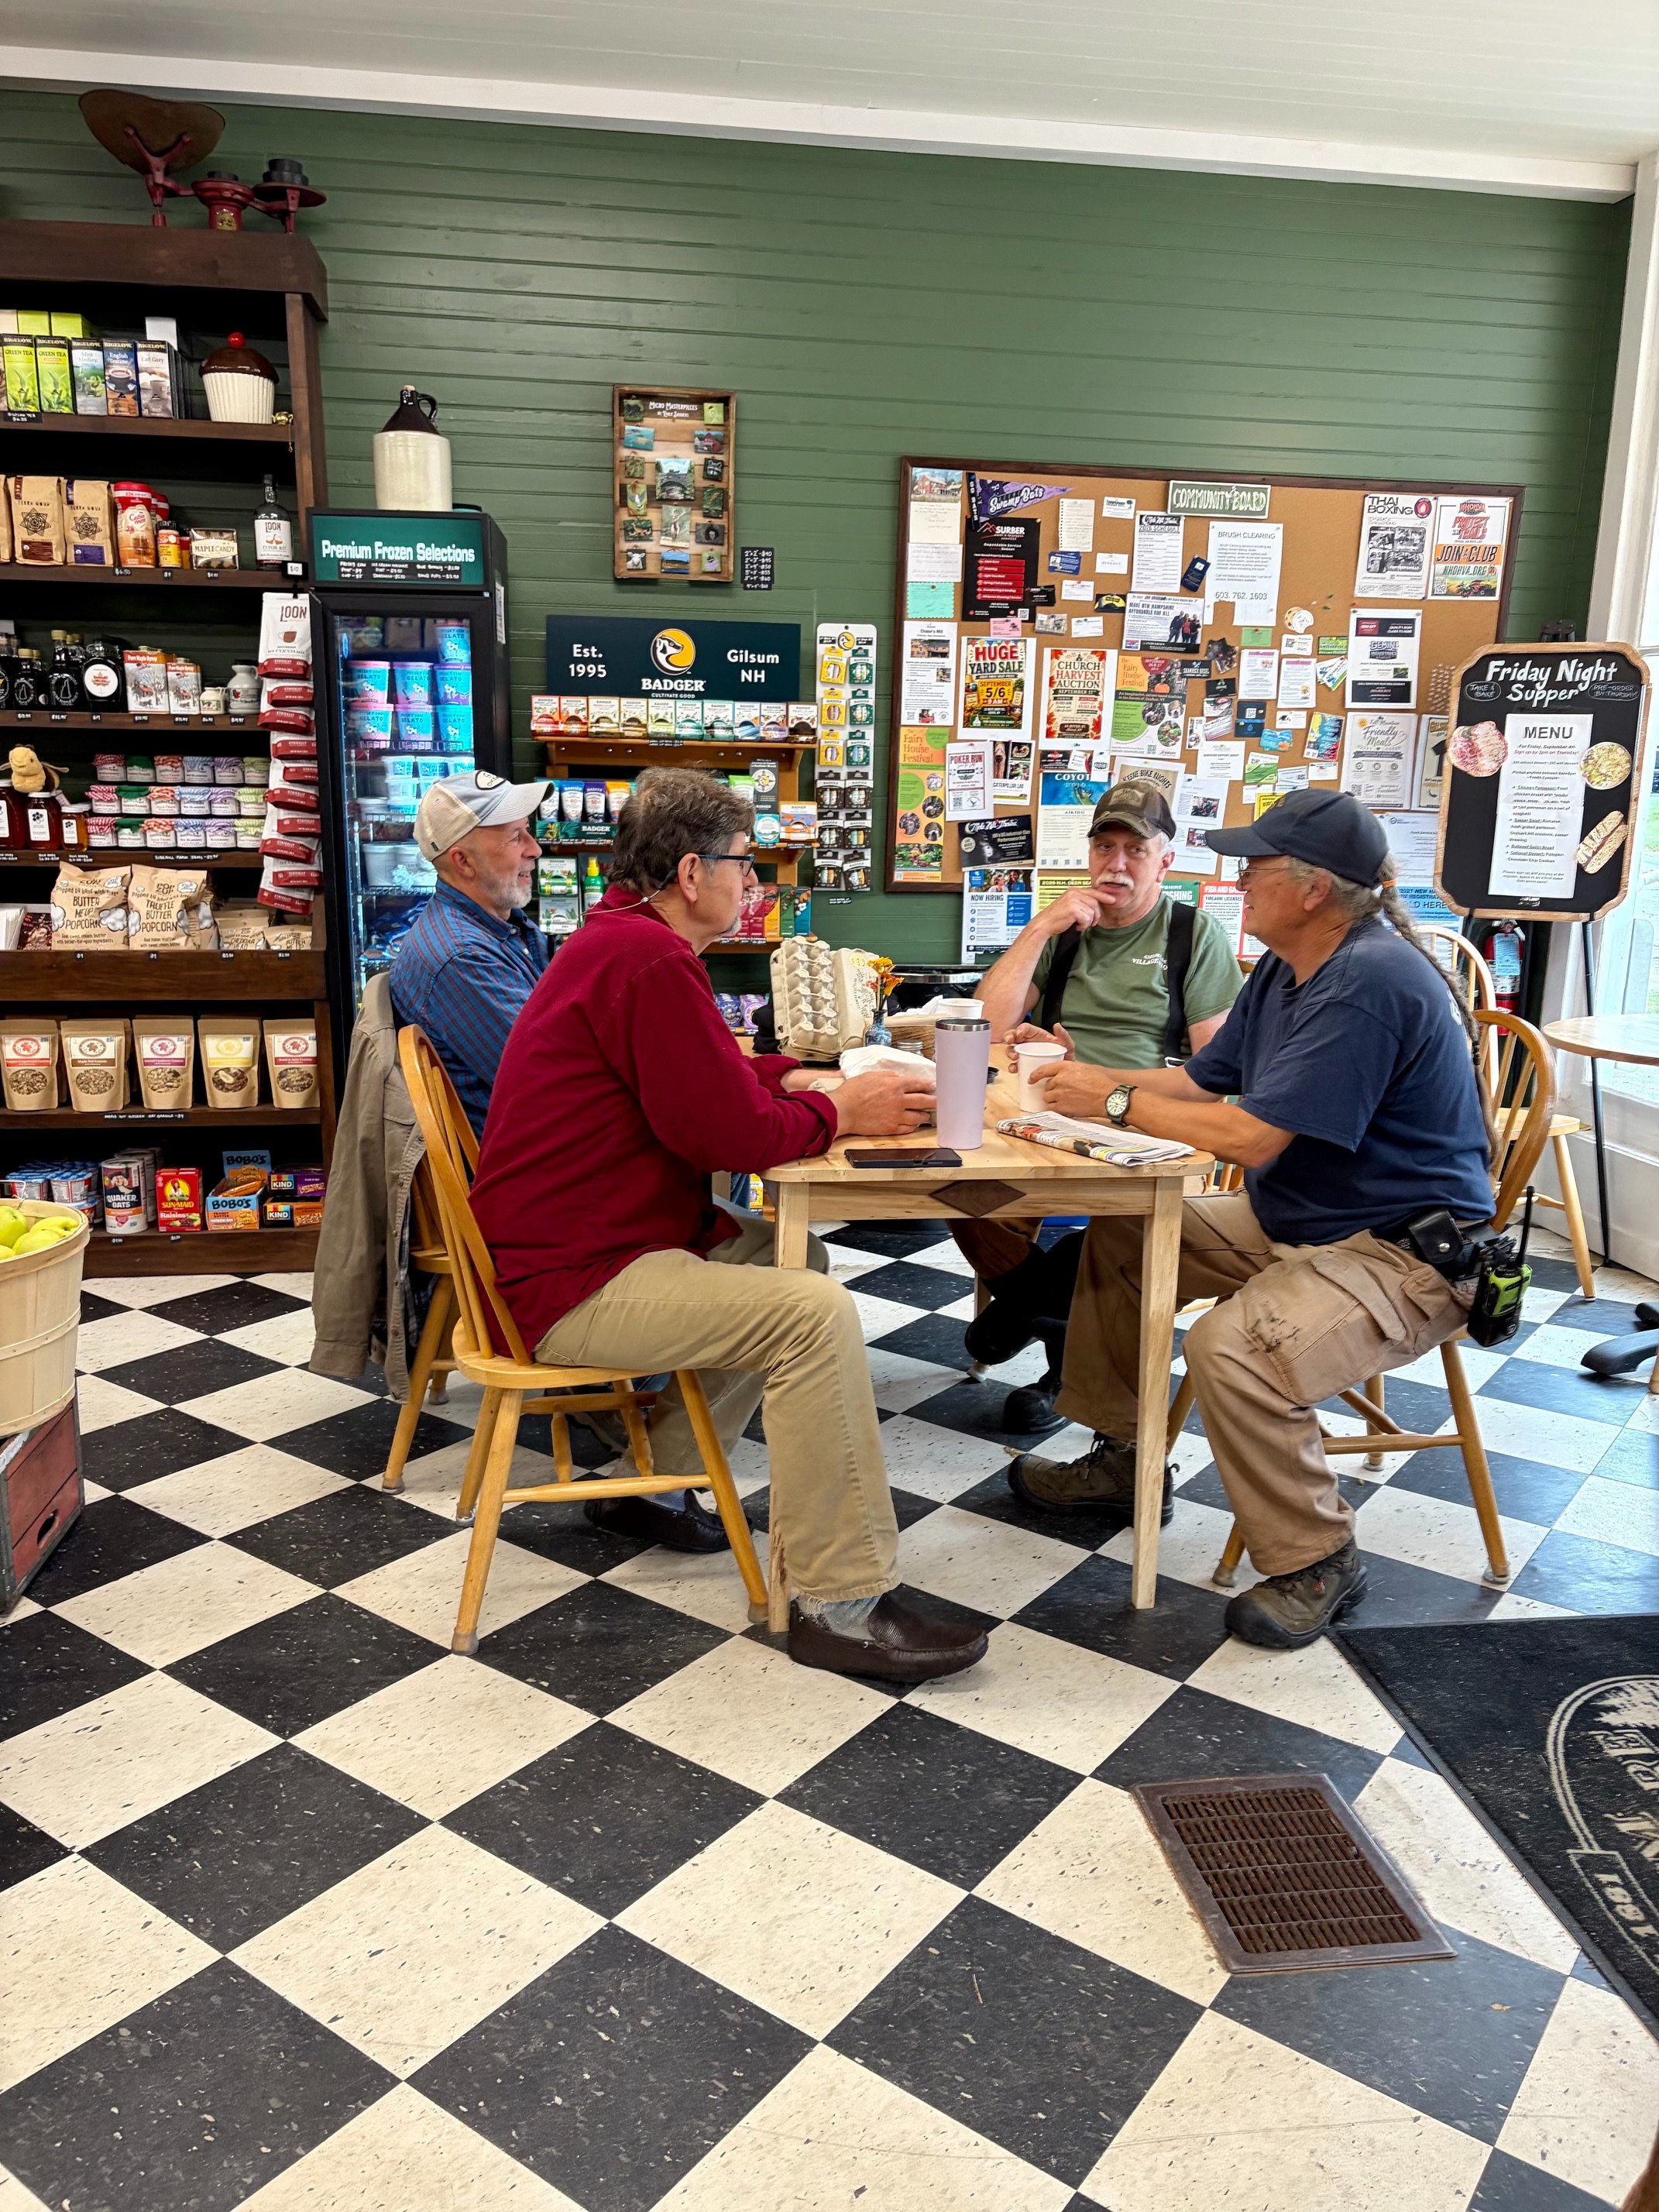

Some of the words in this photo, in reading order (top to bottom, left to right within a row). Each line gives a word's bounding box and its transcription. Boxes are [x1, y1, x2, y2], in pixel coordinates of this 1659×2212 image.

[989, 496, 1021, 513] Swamp
[1021, 486, 1045, 501] Bats
[1173, 486, 1237, 510] COMMUNITY
[1231, 490, 1266, 512] BOARD
[1369, 496, 1399, 506] THAI
[1368, 505, 1413, 514] BOXING
[266, 522, 281, 532] LOON
[996, 526, 1025, 534] SURBER
[321, 540, 372, 558] Premium
[375, 541, 413, 561] Frozen
[417, 543, 476, 562] Selections
[1437, 546, 1462, 562] JOIN
[1467, 546, 1498, 562] CLUB
[280, 606, 307, 622] LOON
[1370, 641, 1399, 650] GEMINI
[573, 644, 603, 658] Est.
[975, 645, 1019, 661] HUGE
[726, 649, 780, 664] Gilsum
[969, 662, 997, 674] YARD
[998, 661, 1023, 673] SALE
[1058, 661, 1100, 670] CHURCH
[1123, 664, 1139, 674] Fairy
[569, 664, 606, 678] 1995
[1056, 670, 1102, 680] HARVEST
[1486, 659, 1552, 691] Friday
[1555, 658, 1618, 692] Night
[740, 670, 765, 683] NH
[641, 678, 705, 692] BADGER
[1056, 680, 1100, 689] AUCTION
[1122, 678, 1144, 687] Festival
[986, 688, 1005, 698] 5/6
[1506, 684, 1579, 708] Supper
[1363, 726, 1399, 739] Friendly
[1523, 726, 1573, 739] MENU
[904, 734, 923, 747] Fairy
[1366, 737, 1393, 746] Meals
[904, 744, 929, 753] House
[903, 754, 933, 763] Festival
[950, 754, 968, 764] POKER
[971, 754, 983, 763] RUN
[1153, 771, 1172, 789] NIGHTS
[73, 896, 100, 906] BUTTER
[146, 899, 175, 909] TRUFFLE
[75, 908, 84, 917] ME
[146, 910, 172, 919] BUTTER
[65, 919, 101, 929] POPCORN
[142, 922, 177, 933] POPCORN
[226, 1155, 266, 1165] BOBO'S
[212, 1200, 252, 1209] BOBO'S
